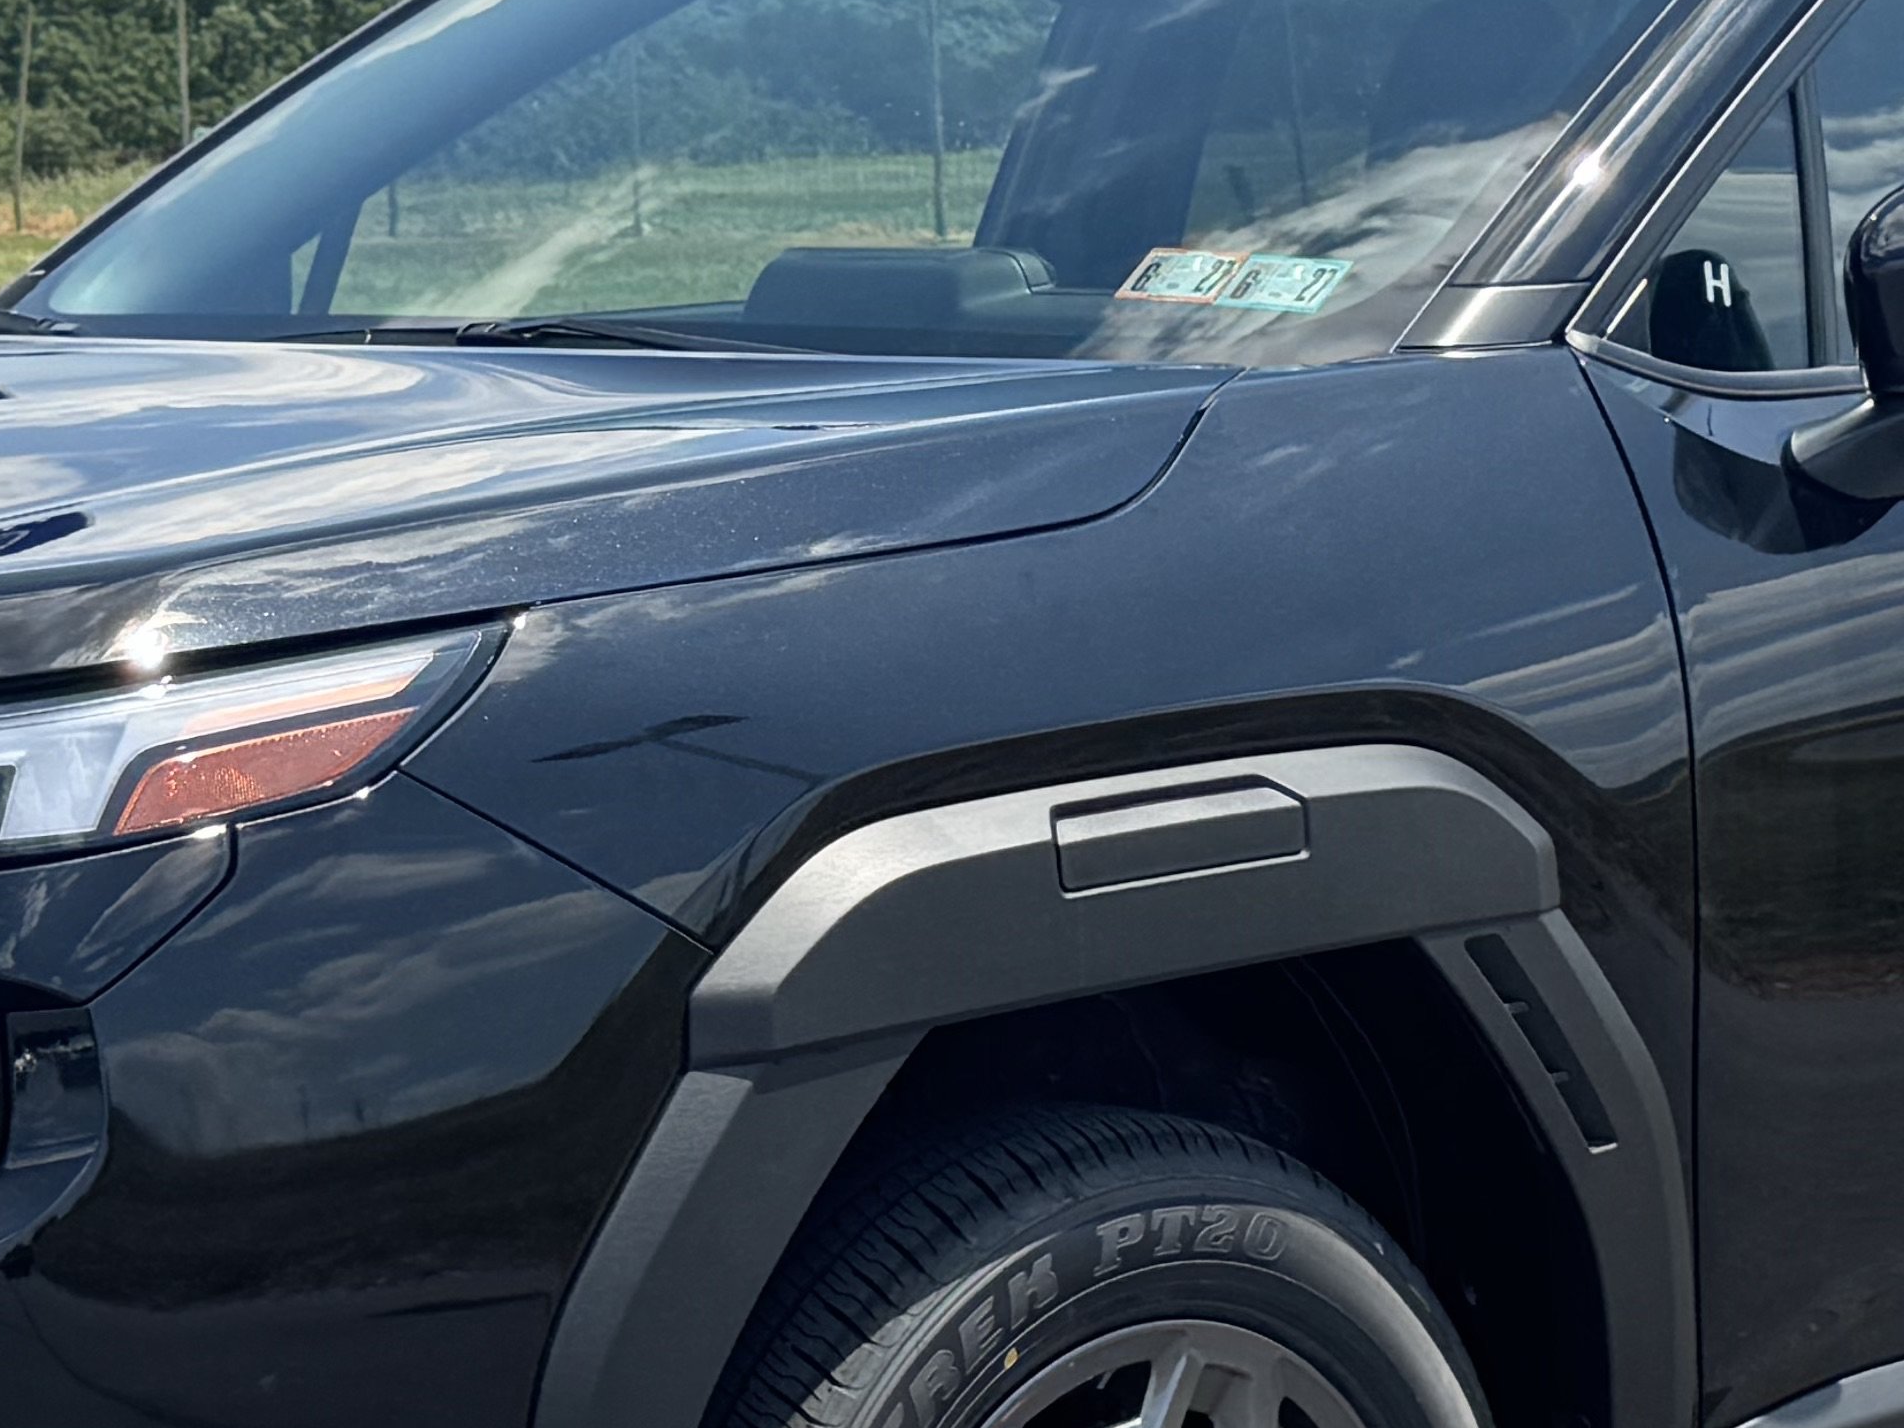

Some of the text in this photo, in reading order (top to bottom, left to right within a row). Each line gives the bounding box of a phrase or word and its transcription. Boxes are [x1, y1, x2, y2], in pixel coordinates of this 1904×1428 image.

[1192, 258, 1236, 296] 27
[1293, 267, 1339, 303] 27
[1703, 260, 1732, 308] H
[1094, 1203, 1288, 1274] PT20
